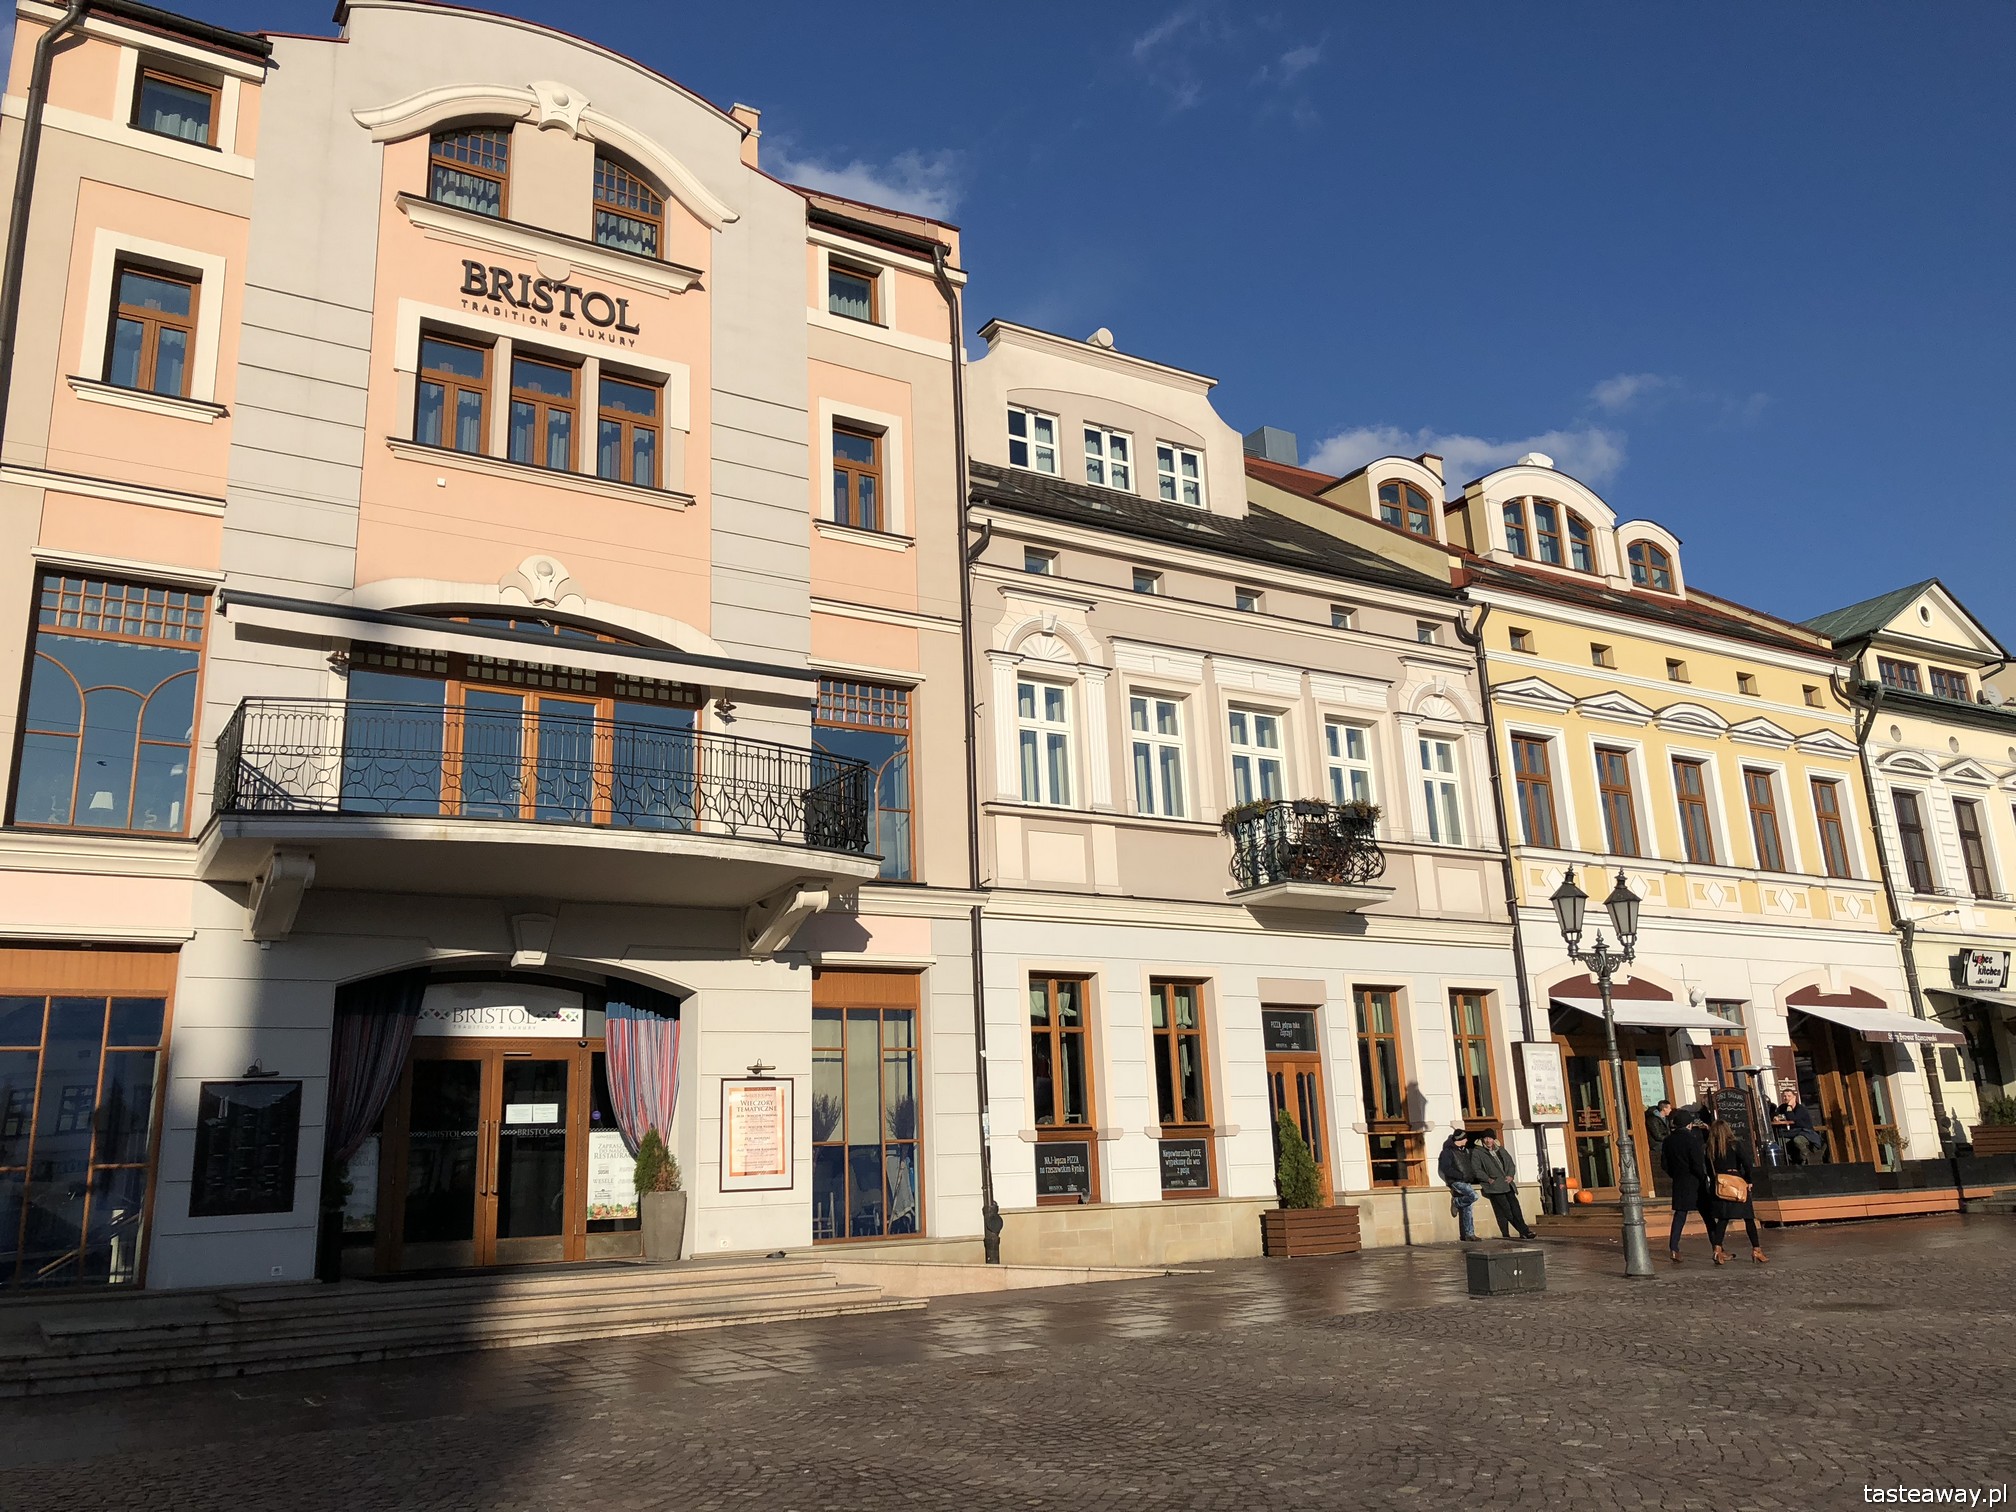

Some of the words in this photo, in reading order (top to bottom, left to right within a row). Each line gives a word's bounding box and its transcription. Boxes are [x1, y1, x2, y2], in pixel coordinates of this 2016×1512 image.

[460, 259, 640, 335] BRISTOL
[461, 299, 549, 327] TRADITION
[559, 322, 568, 332] &
[579, 327, 636, 347] LUXURY
[1978, 966, 2001, 976] kitchen
[452, 1007, 537, 1024] BRISTOL
[427, 1130, 461, 1138] BRISTOL
[517, 1128, 550, 1136] BRISTOL
[1067, 1155, 1079, 1163] PIZZA
